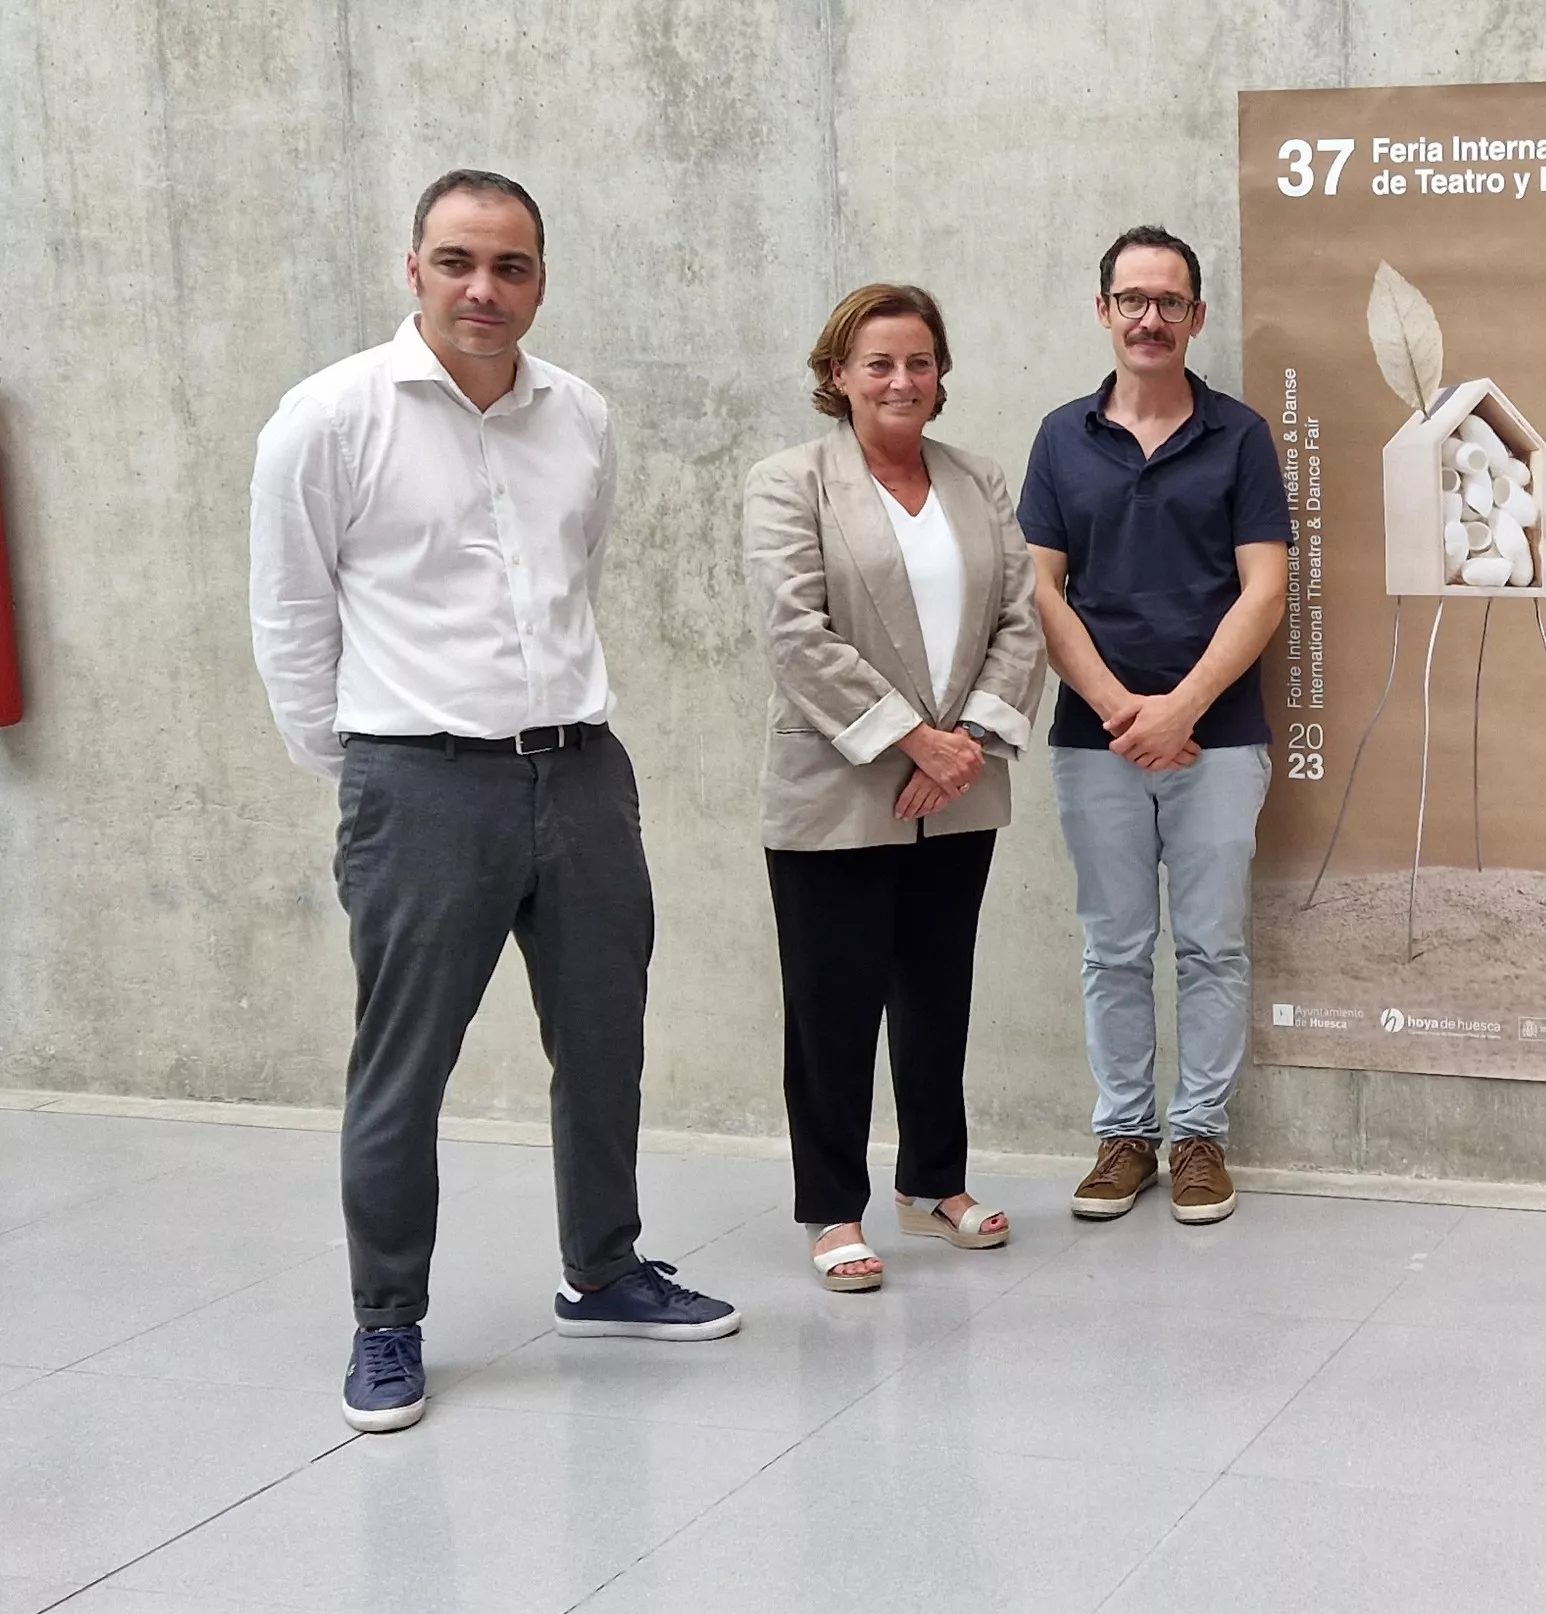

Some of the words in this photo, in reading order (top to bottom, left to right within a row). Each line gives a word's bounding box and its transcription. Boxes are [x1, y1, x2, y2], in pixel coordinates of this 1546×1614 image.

[1372, 137, 1443, 163] Feria
[1277, 138, 1355, 197] 37
[1371, 169, 1407, 195] de
[1415, 168, 1505, 195] Teatro
[1513, 171, 1531, 199] y
[1282, 368, 1297, 424] Danse
[1283, 429, 1298, 443] &
[1304, 416, 1320, 450] Fair
[1305, 456, 1321, 511] Dance
[1307, 516, 1322, 530] &
[1306, 534, 1323, 600] Theatre
[1287, 545, 1301, 660] Internationale
[1308, 605, 1324, 709] International
[1287, 667, 1302, 709] Foire
[1288, 723, 1325, 750] 20
[1288, 752, 1325, 780] 23
[1295, 1005, 1364, 1019] Ayuntamiento
[1295, 1018, 1307, 1028] de
[1310, 1017, 1347, 1029] Huesca
[1407, 1015, 1438, 1031] hoya
[1457, 1017, 1501, 1033] huesca
